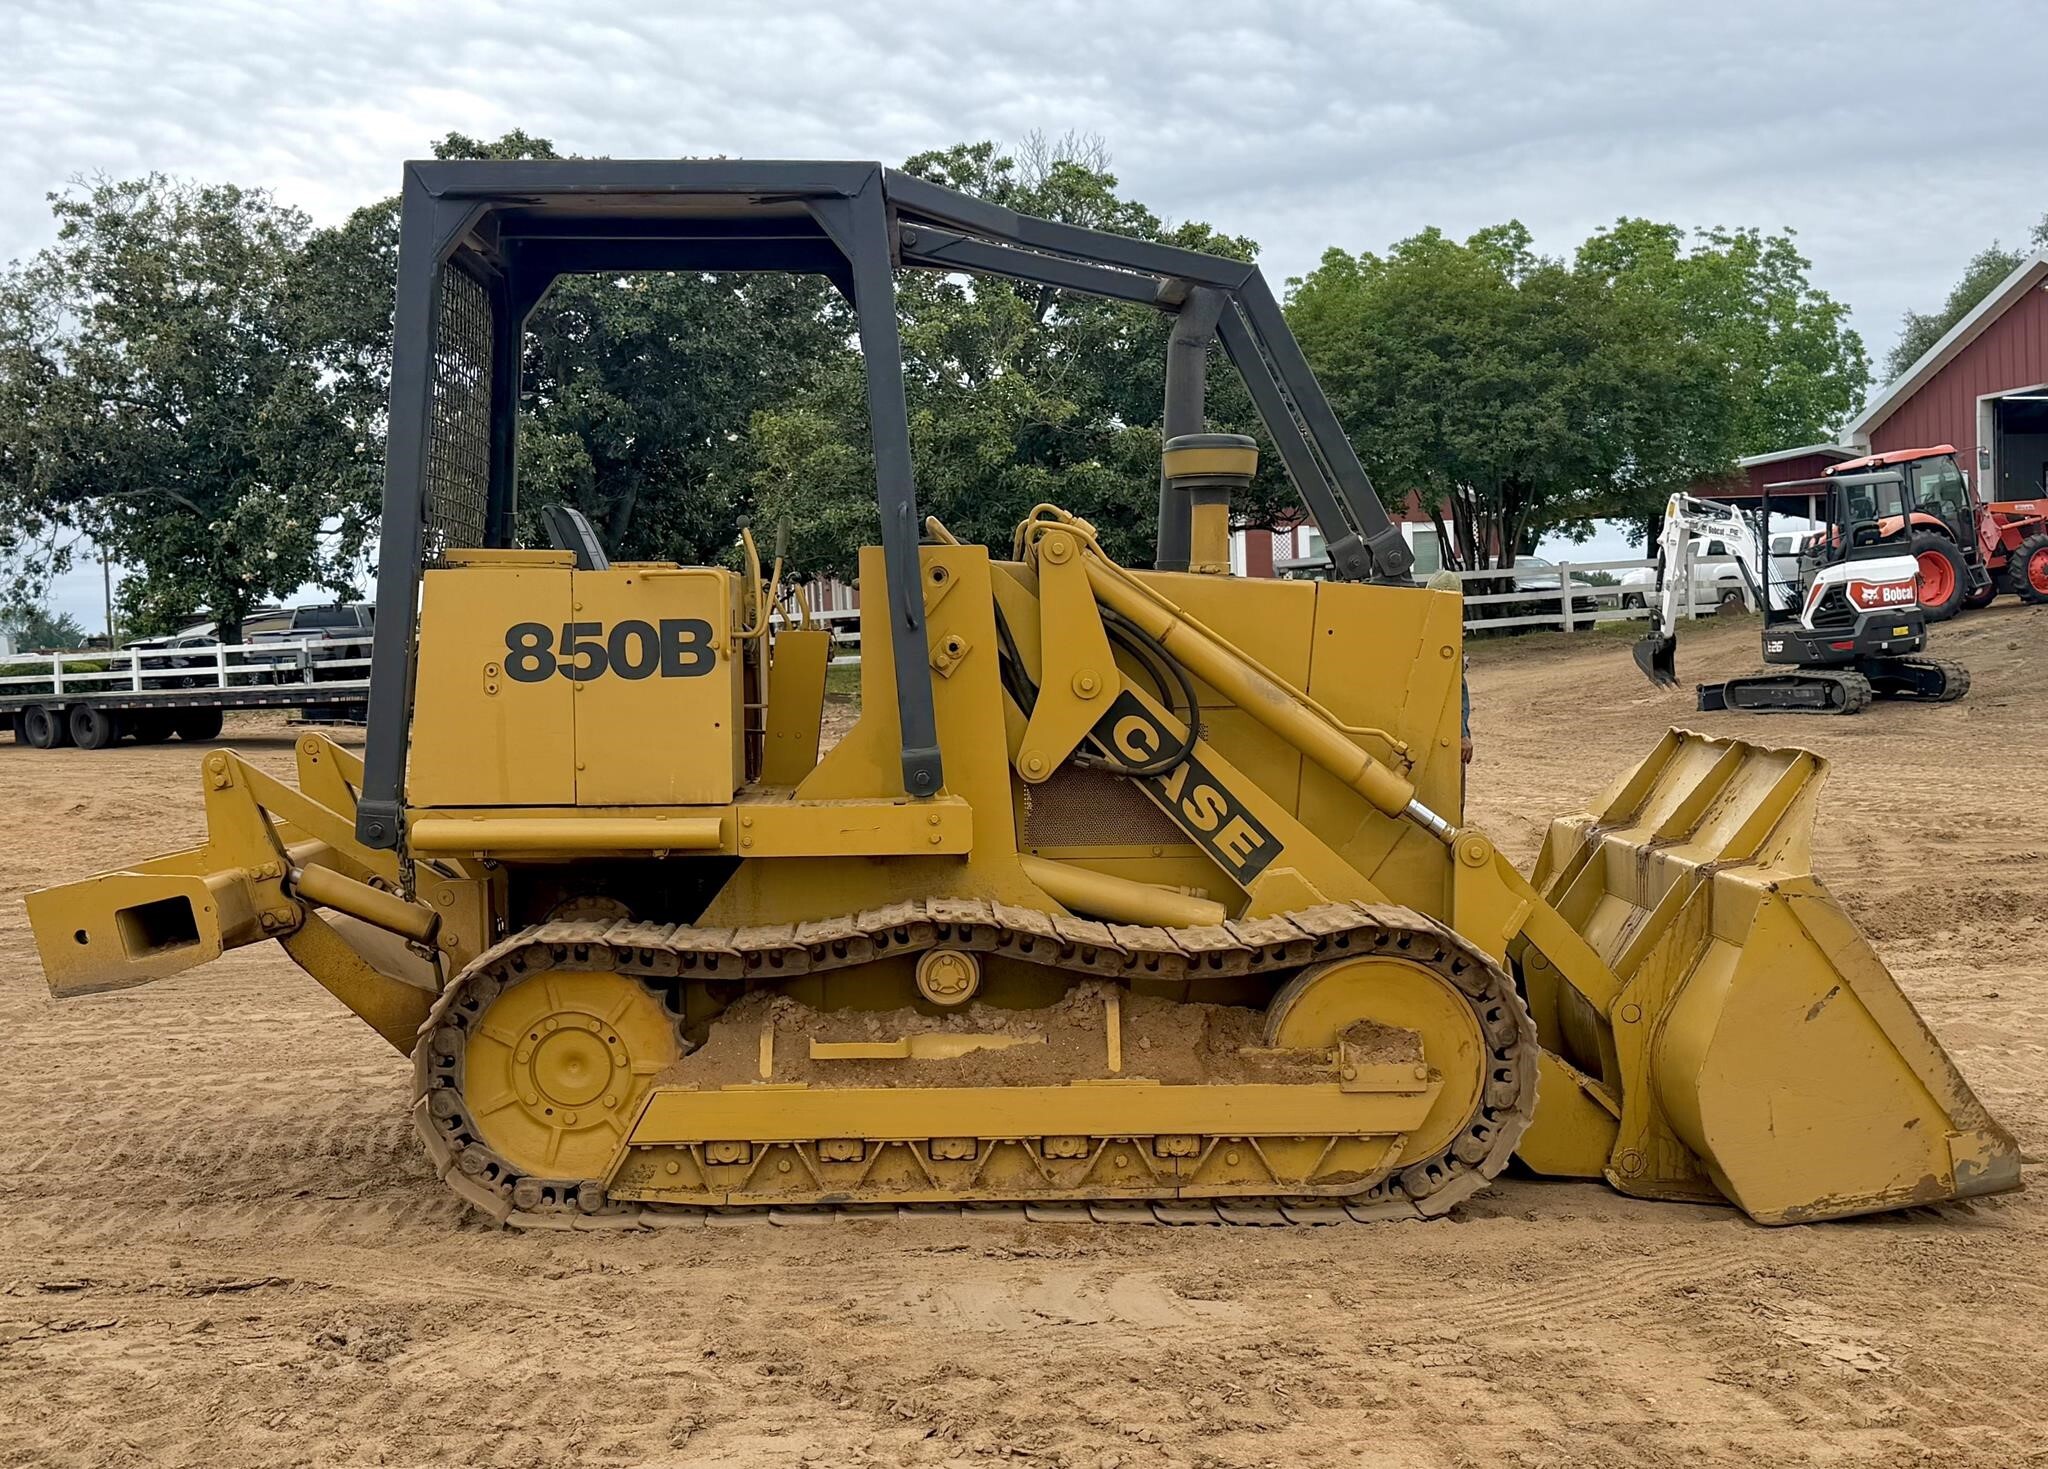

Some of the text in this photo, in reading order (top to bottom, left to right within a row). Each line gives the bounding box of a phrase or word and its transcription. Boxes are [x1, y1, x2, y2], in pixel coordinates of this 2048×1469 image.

[1882, 585, 1914, 602] Bobcat
[504, 619, 715, 682] 850B
[1113, 715, 1265, 868] CASE
